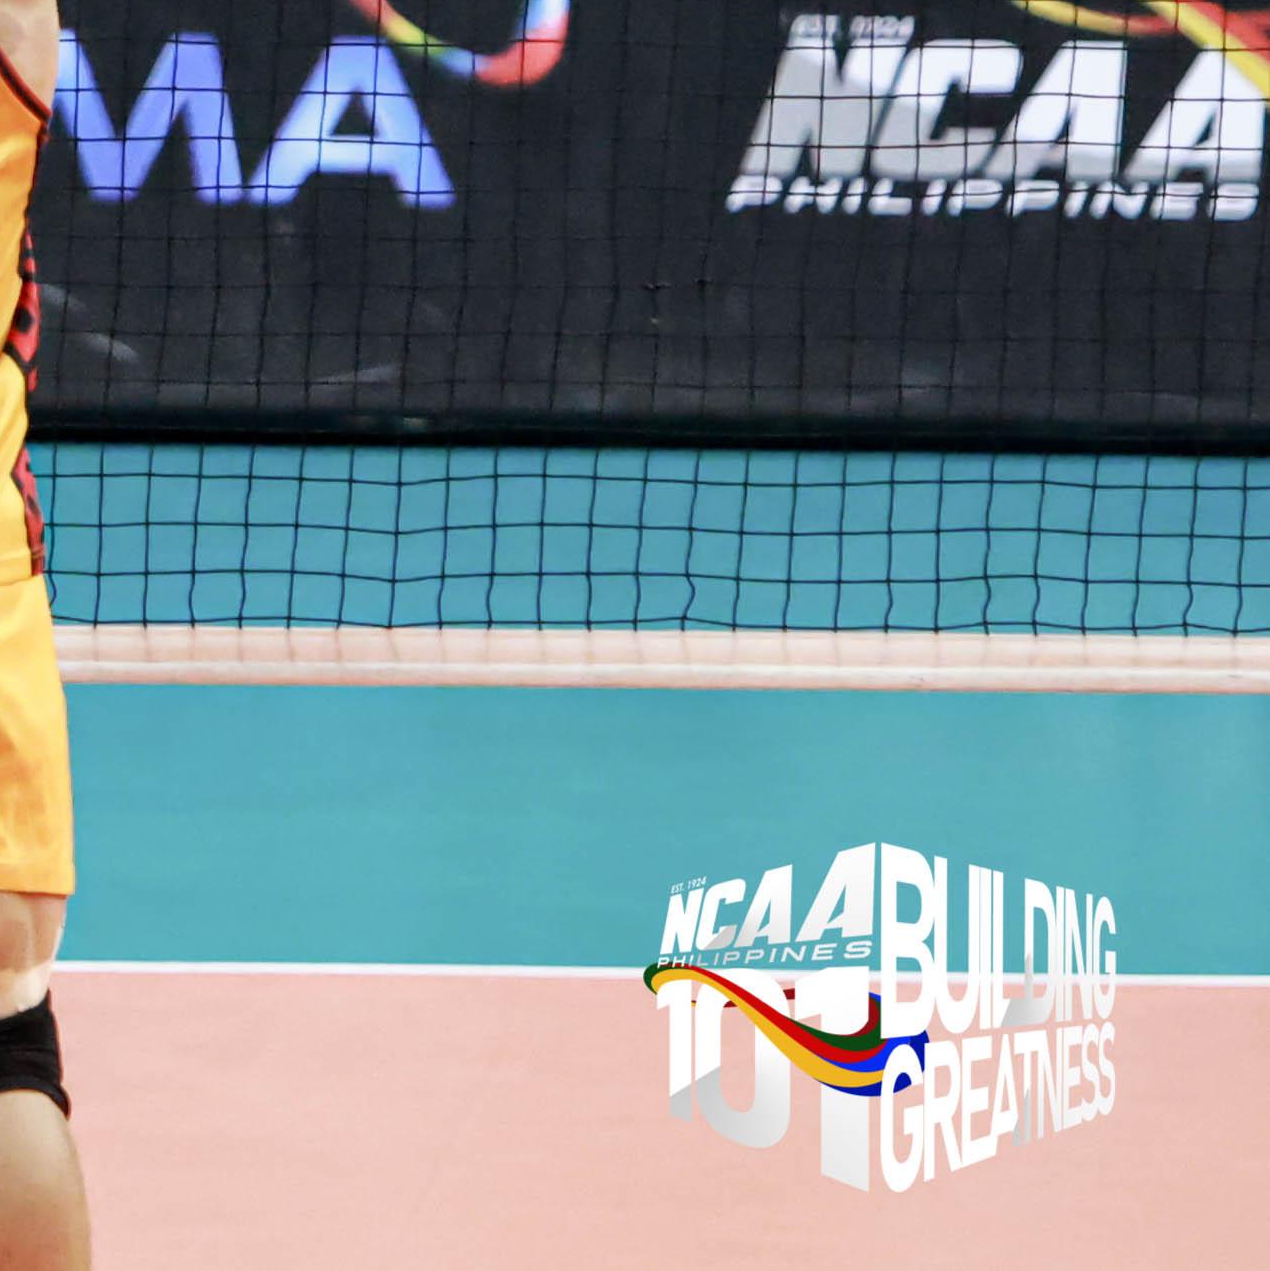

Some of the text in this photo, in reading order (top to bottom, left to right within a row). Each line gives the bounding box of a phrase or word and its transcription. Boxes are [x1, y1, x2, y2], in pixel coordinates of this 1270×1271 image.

[55, 28, 457, 209] MA
[735, 38, 1267, 183] NCAA
[725, 175, 1259, 221] PHILIPPINES
